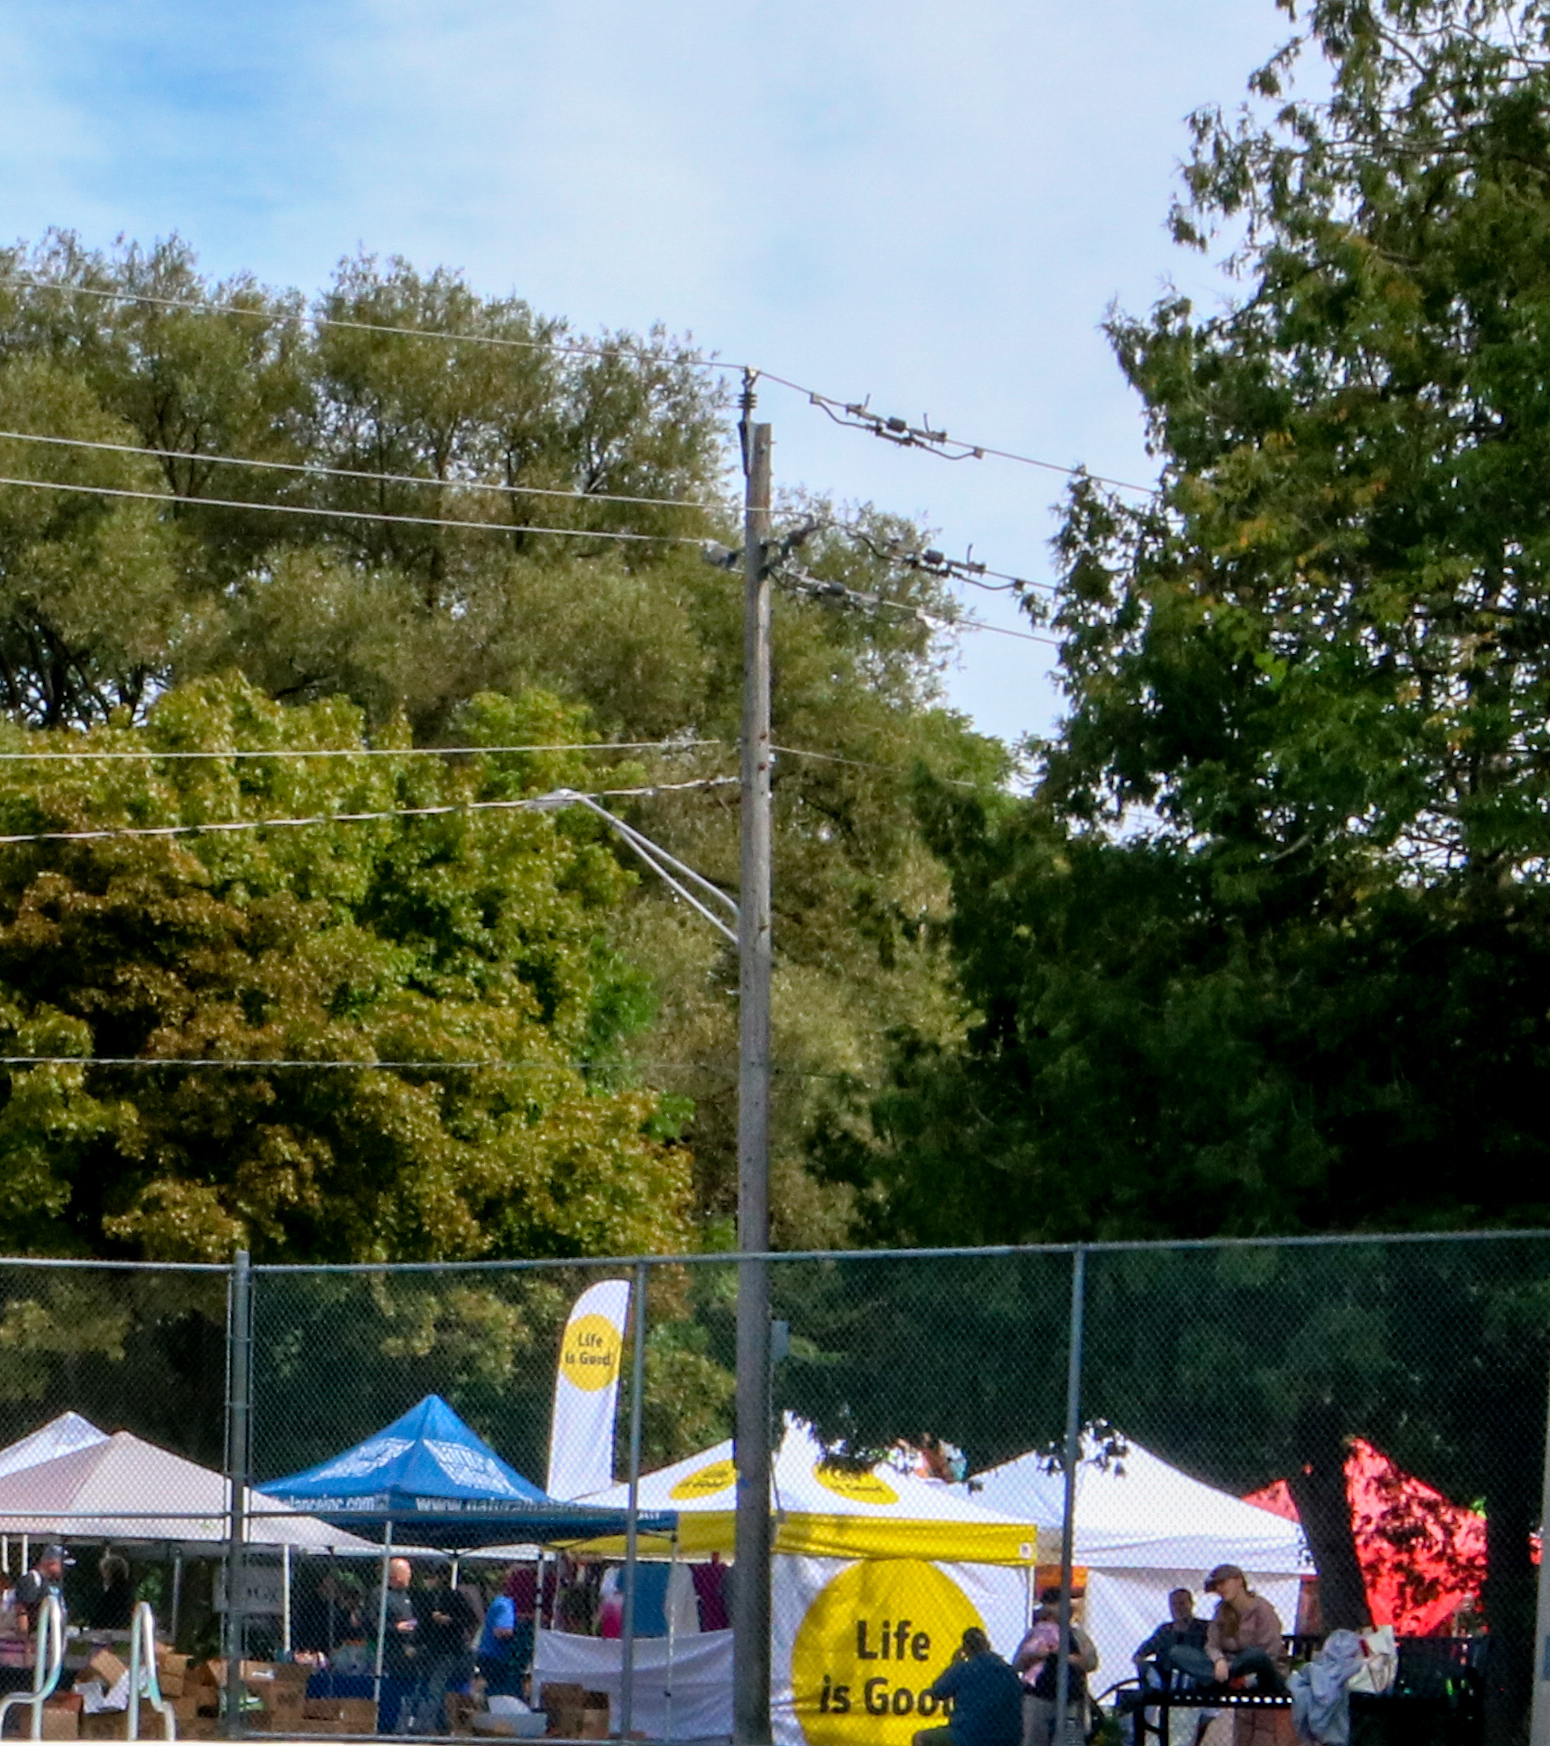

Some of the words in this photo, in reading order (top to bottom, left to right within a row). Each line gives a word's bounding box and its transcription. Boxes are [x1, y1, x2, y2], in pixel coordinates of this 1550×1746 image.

[578, 1333, 603, 1347] Life
[857, 1620, 931, 1661] Life
[820, 1674, 852, 1714] is
